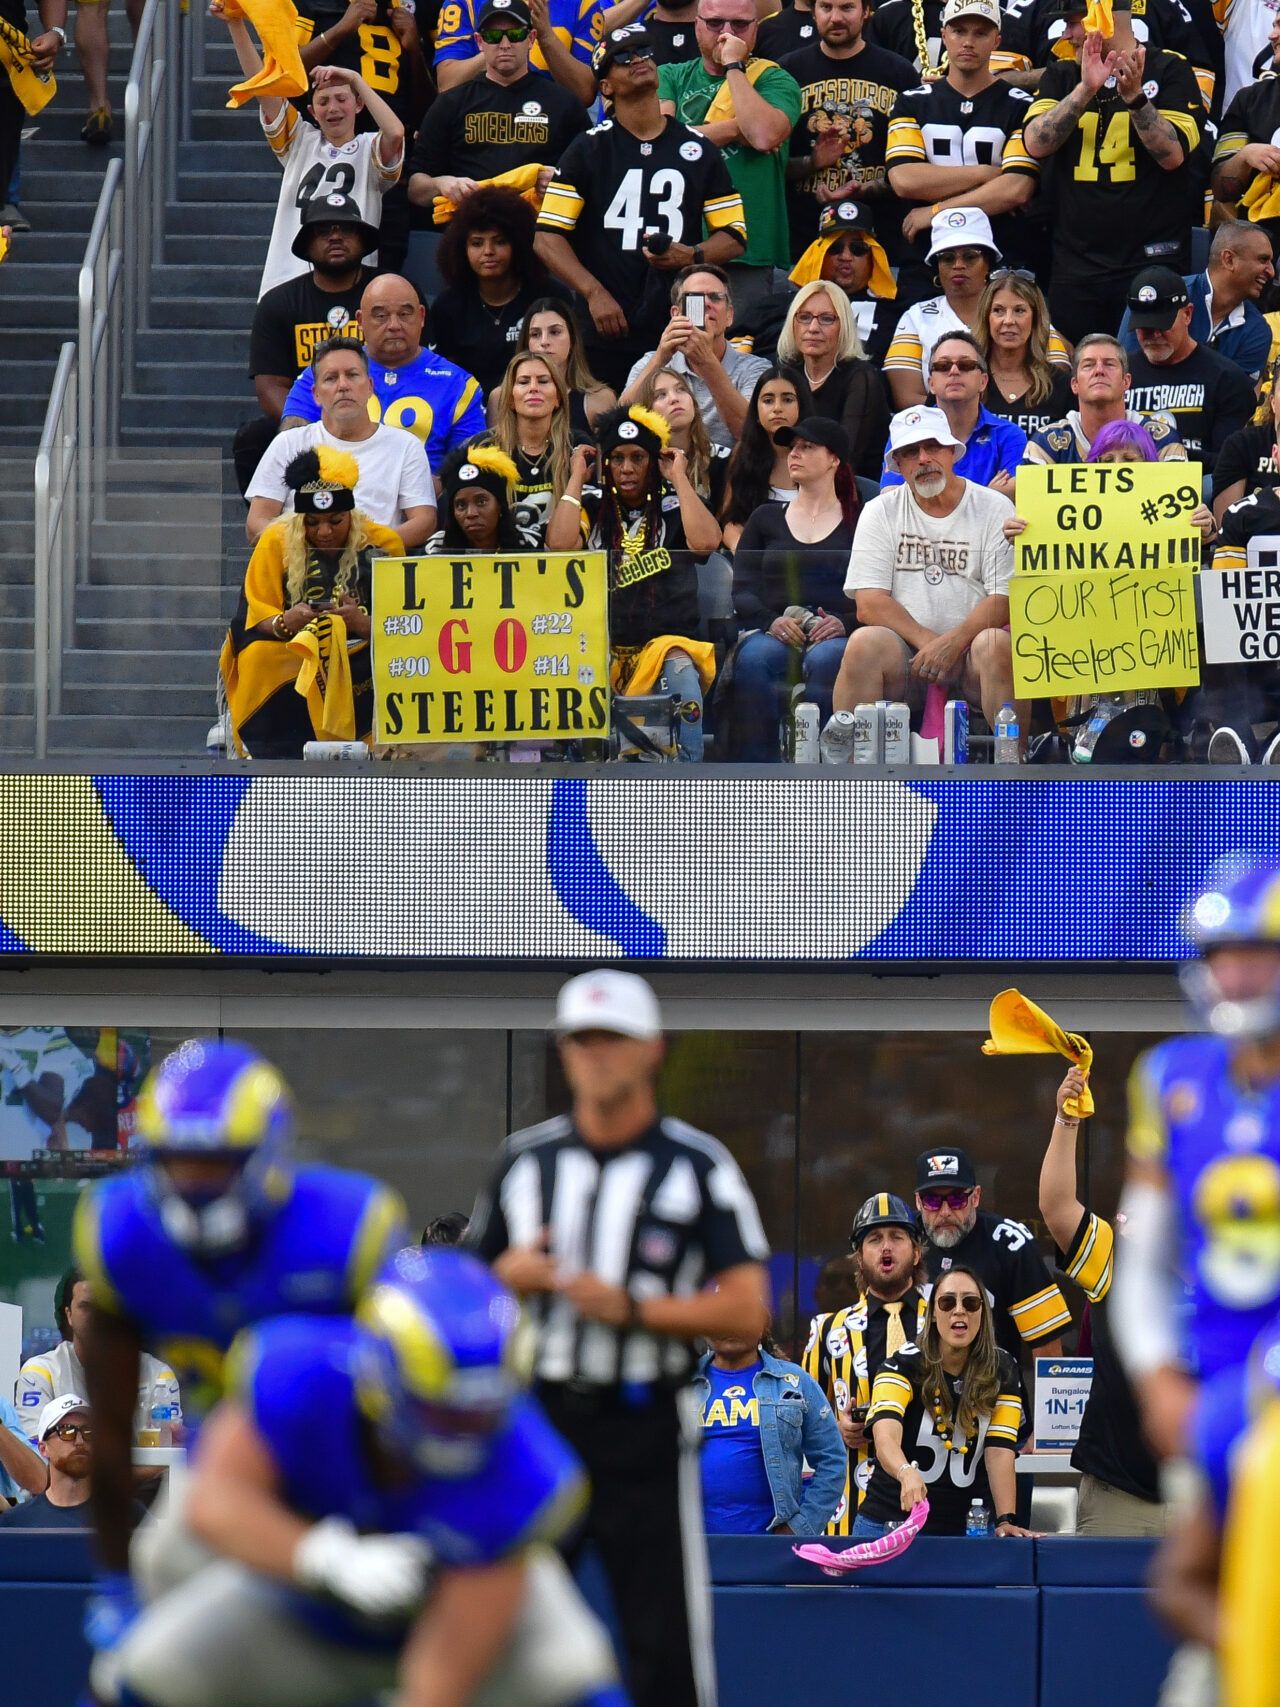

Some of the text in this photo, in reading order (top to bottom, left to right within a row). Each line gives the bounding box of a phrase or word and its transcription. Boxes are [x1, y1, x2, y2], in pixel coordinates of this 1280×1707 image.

[360, 25, 401, 95] 8
[465, 112, 549, 144] STEELERS
[1074, 111, 1136, 182] 14
[604, 168, 686, 250] 43
[425, 367, 452, 377] RAMS
[1124, 384, 1205, 409] PITTSBURGH
[1047, 467, 1134, 494] LETS
[1057, 504, 1102, 531] GO
[1140, 485, 1199, 525] #39
[896, 543, 969, 572] STEELERS
[402, 558, 587, 611] LET'S
[1024, 574, 1188, 627] OUR First
[383, 614, 423, 636] #30
[532, 612, 573, 635] #22
[438, 618, 528, 674] GO
[1016, 628, 1198, 684] Steelers GAME
[388, 656, 431, 678] #90
[533, 655, 570, 676] #14
[385, 686, 607, 736] STEELERS
[1062, 1366, 1094, 1374] RAMS
[1045, 1398, 1088, 1415] 1N-1
[1051, 1387, 1091, 1398] Bungalow
[917, 1408, 989, 1489] 50
